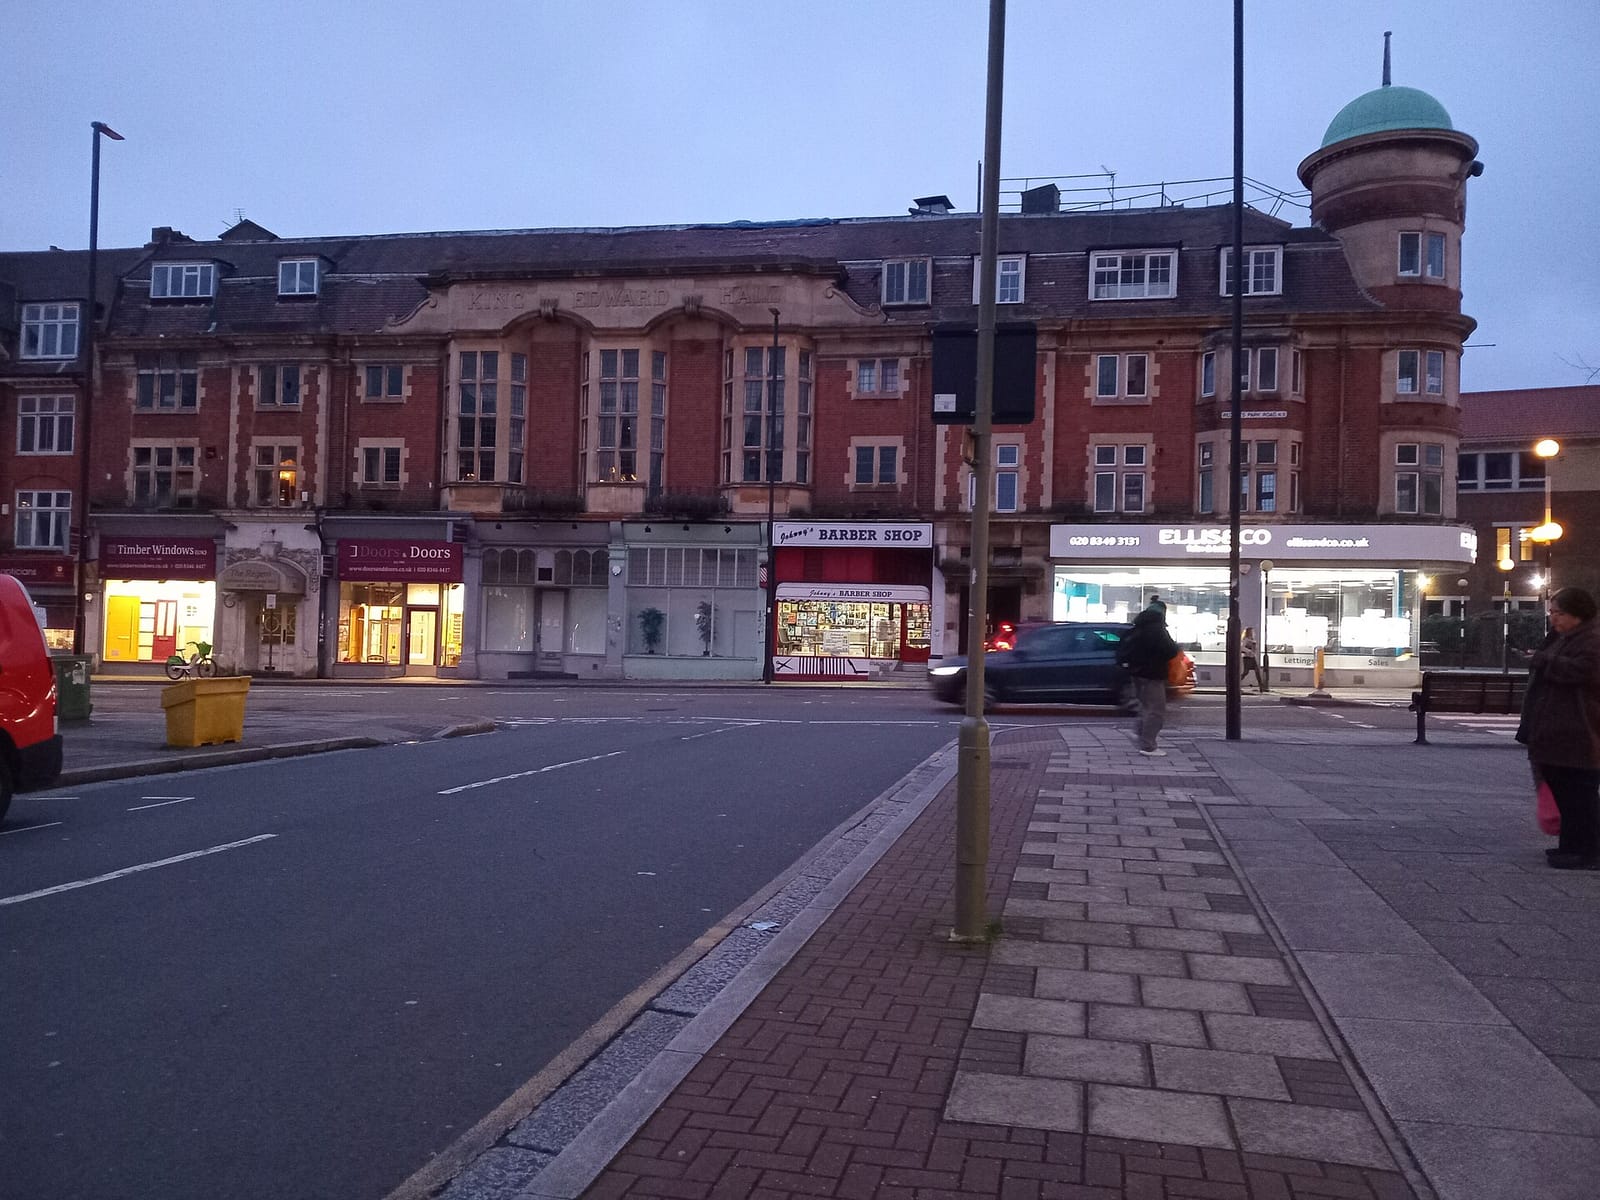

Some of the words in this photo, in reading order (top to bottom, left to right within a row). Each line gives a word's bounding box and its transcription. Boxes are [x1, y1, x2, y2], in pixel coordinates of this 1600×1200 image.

[467, 291, 525, 310] KING
[572, 288, 670, 308] EDWARD
[719, 286, 781, 305] HALL
[780, 527, 814, 544] Johnny's
[818, 529, 878, 541] BARBER
[884, 529, 923, 541] SHOP
[1069, 536, 1089, 546] 020
[1089, 536, 1117, 546] 8349
[1117, 536, 1140, 546] 3131
[117, 544, 151, 555] Timber
[152, 544, 194, 555] Windows
[360, 545, 400, 558] Doors
[410, 546, 451, 559] Doors
[809, 590, 836, 598] Johnny's
[872, 590, 892, 598] SHOP
[1284, 656, 1315, 665] Lettings
[1368, 658, 1389, 666] Sales
